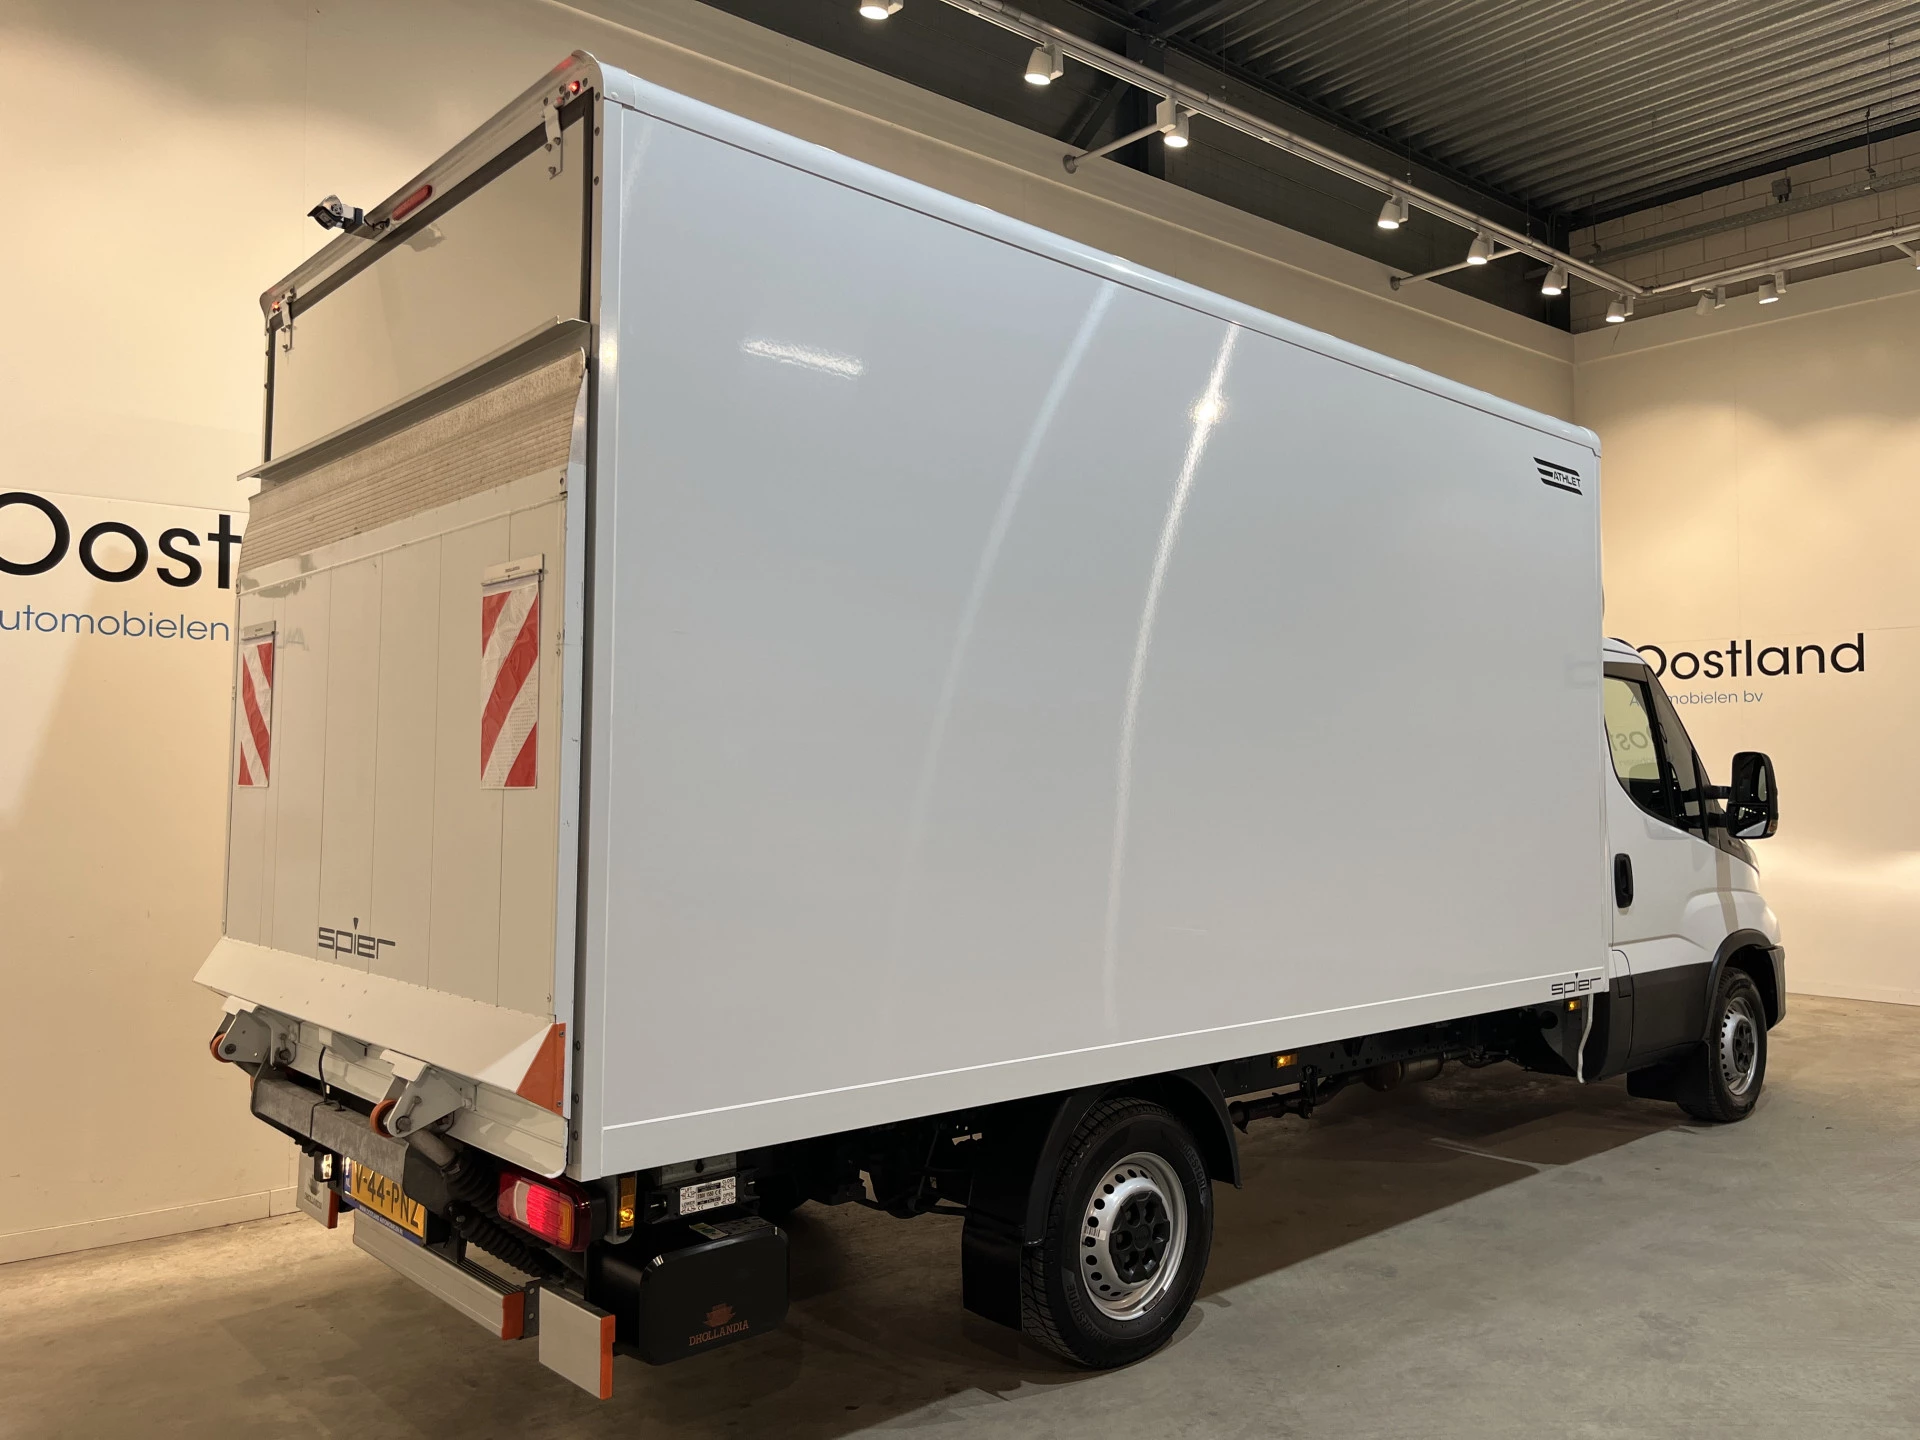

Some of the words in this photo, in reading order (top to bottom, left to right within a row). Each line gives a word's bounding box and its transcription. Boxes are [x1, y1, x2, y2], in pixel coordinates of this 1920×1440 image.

[1553, 471, 1581, 488] ATHLET
[1629, 689, 1738, 706] Amobielen
[1743, 690, 1763, 703] bv
[318, 917, 396, 960] spier
[1551, 972, 1602, 1000] spier
[689, 1319, 750, 1347] DHOLLANDIA
